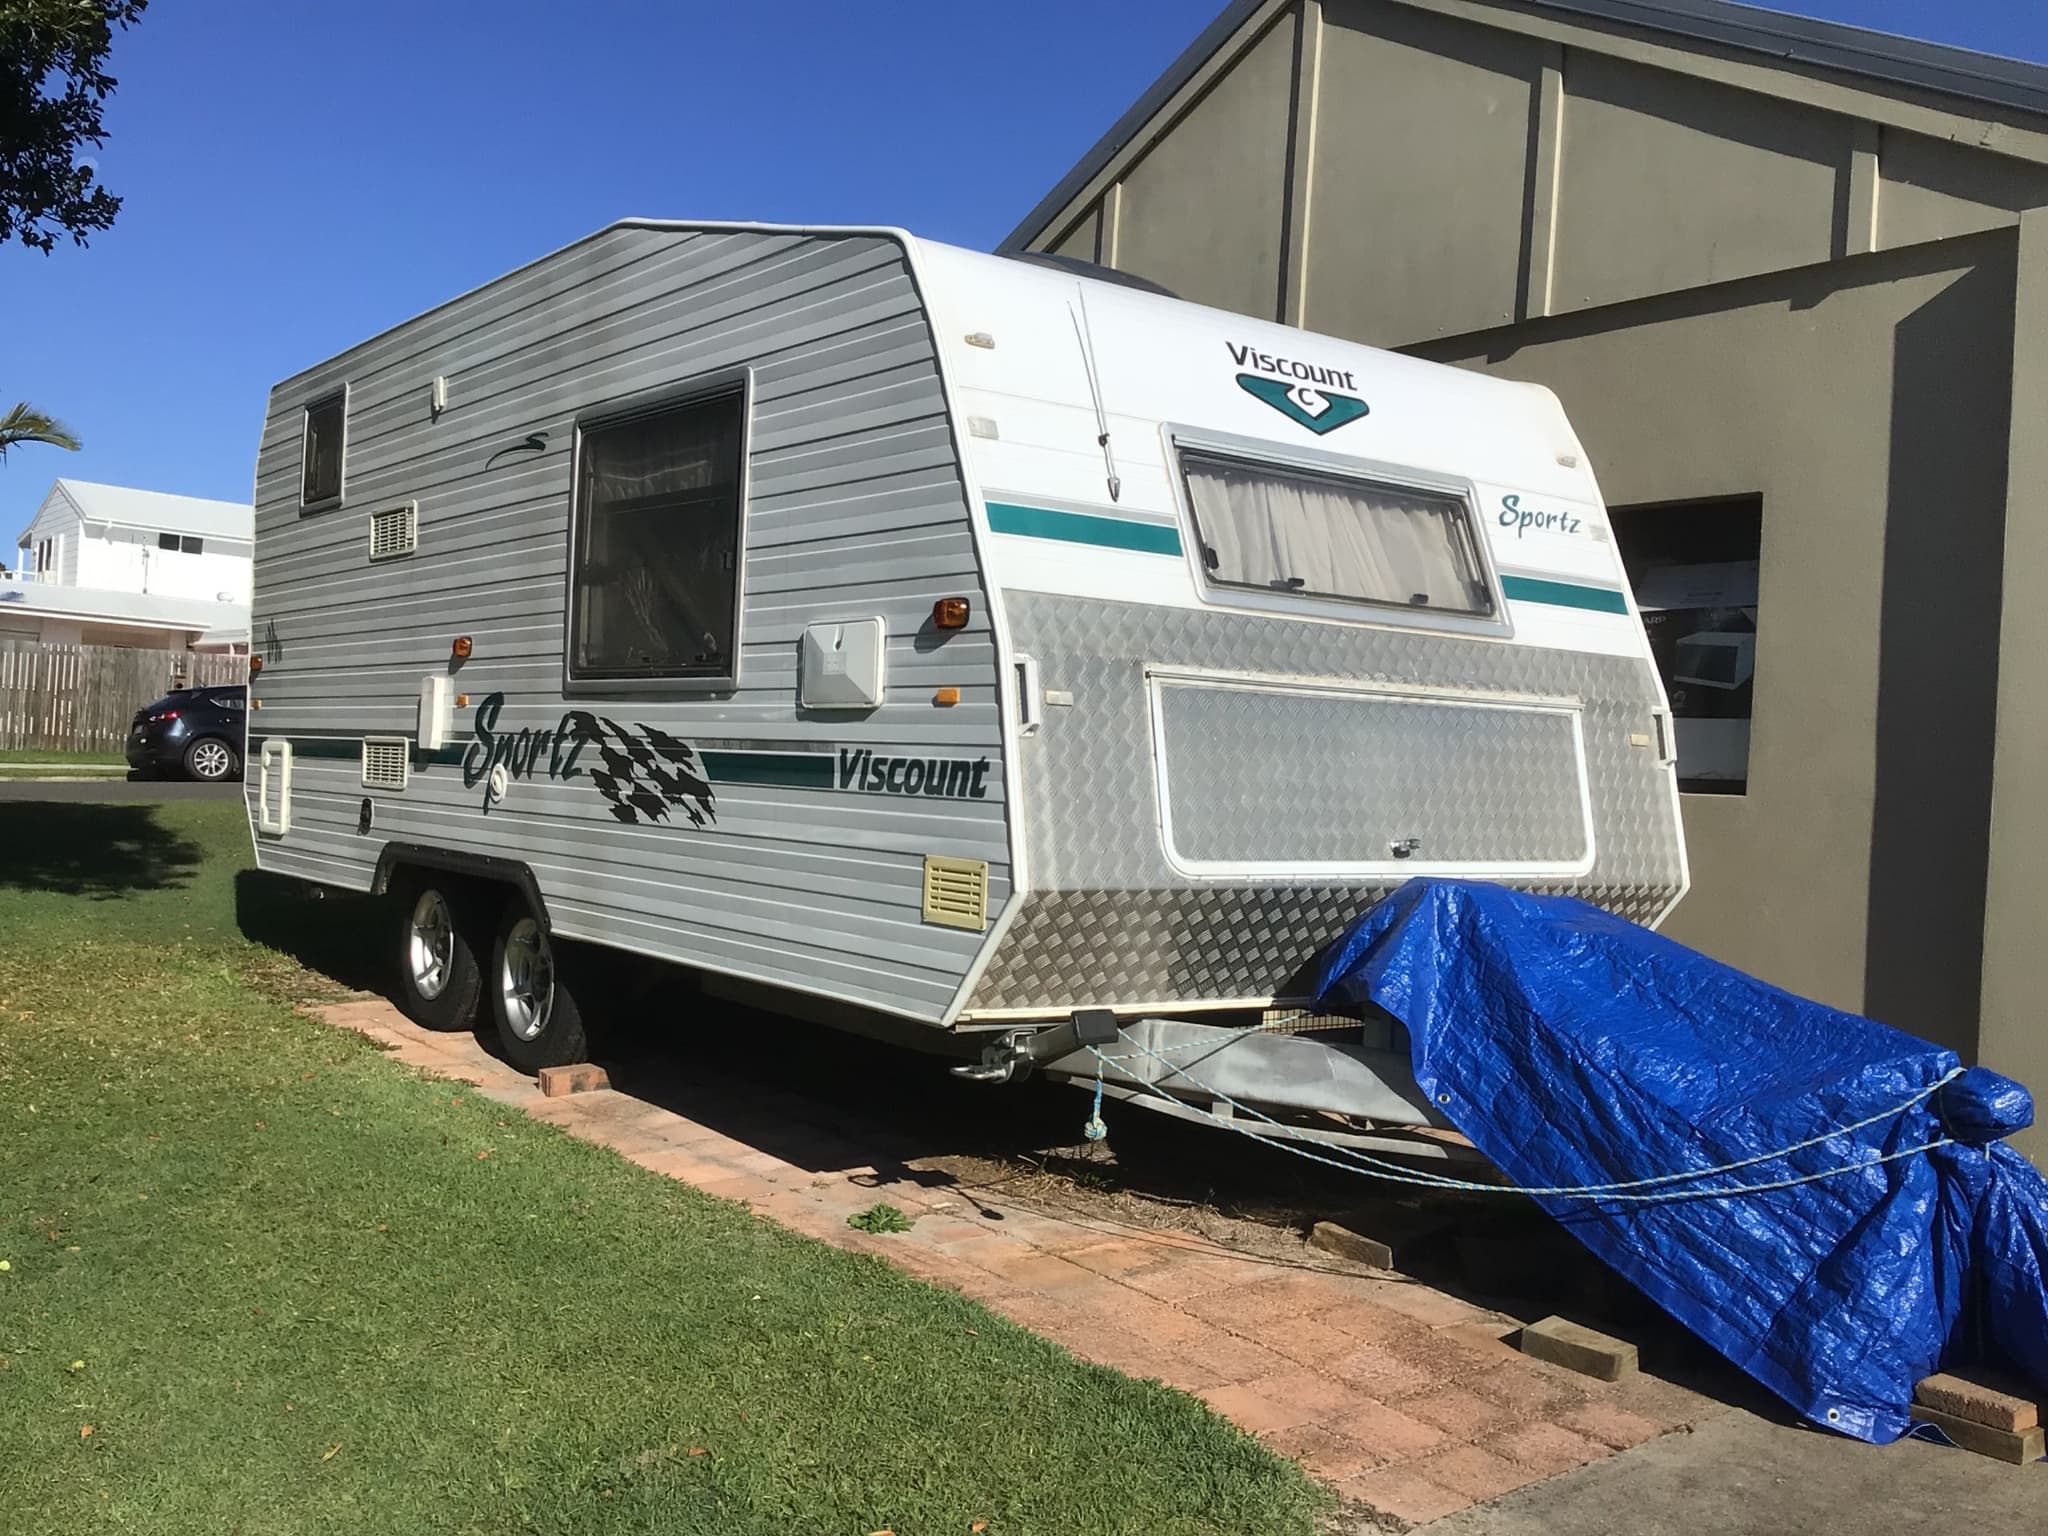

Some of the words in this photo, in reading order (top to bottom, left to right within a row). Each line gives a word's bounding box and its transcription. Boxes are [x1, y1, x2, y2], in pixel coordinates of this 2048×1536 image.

[1225, 341, 1358, 391] Viscount
[1498, 494, 1581, 539] Sportz
[1643, 615, 1666, 625] ARP
[464, 691, 590, 816] Sportz
[839, 748, 990, 798] Viscount
